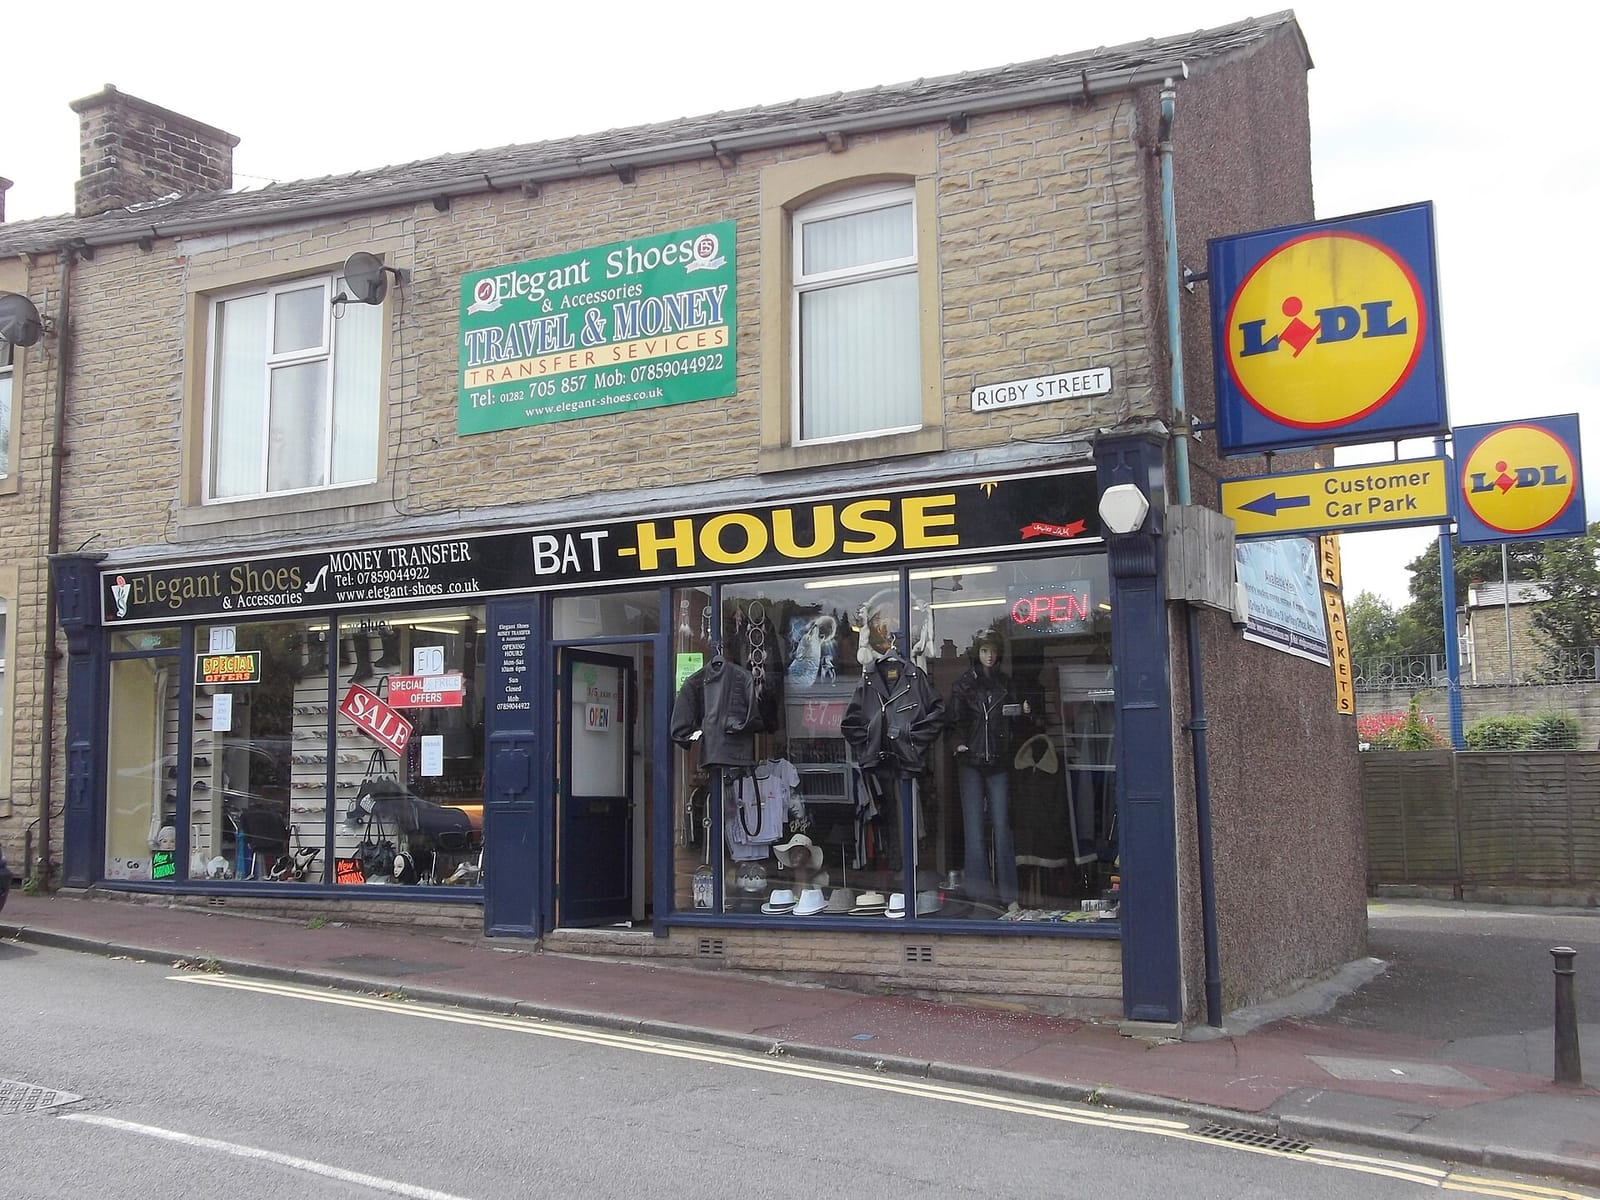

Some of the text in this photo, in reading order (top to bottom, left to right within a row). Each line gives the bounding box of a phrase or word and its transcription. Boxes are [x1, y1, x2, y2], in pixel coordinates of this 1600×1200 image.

[495, 238, 693, 301] Elegant Shoes
[542, 283, 642, 313] & Accessories
[464, 284, 728, 366] TRAVEL & MONEY
[470, 329, 723, 384] TRANSFER SEVICES
[470, 353, 723, 408] Tel: 01282 705 857 Mob: 07859044922
[977, 373, 1104, 406] RIGBY STREET
[525, 387, 663, 417] www.elegant-shoes.co.uk
[1324, 471, 1431, 495] Customer
[1326, 494, 1417, 518] Car Park
[329, 541, 472, 573] MONEY TRANSFER
[531, 529, 609, 576] BAT
[131, 562, 303, 609] Elegant Shoes
[335, 566, 430, 587] Tel: 07859044922
[222, 590, 303, 610] & Accessories
[1011, 593, 1088, 625] OPEN
[212, 628, 235, 651] EID
[1329, 595, 1349, 710] JACKETS
[203, 655, 254, 675] SPECIAL
[417, 649, 442, 672] EID
[205, 672, 251, 682] OFFERS
[391, 680, 424, 691] SPECIAL
[410, 693, 442, 703] OFFERS
[348, 693, 408, 750] SALE
[589, 706, 609, 728] OPEN
